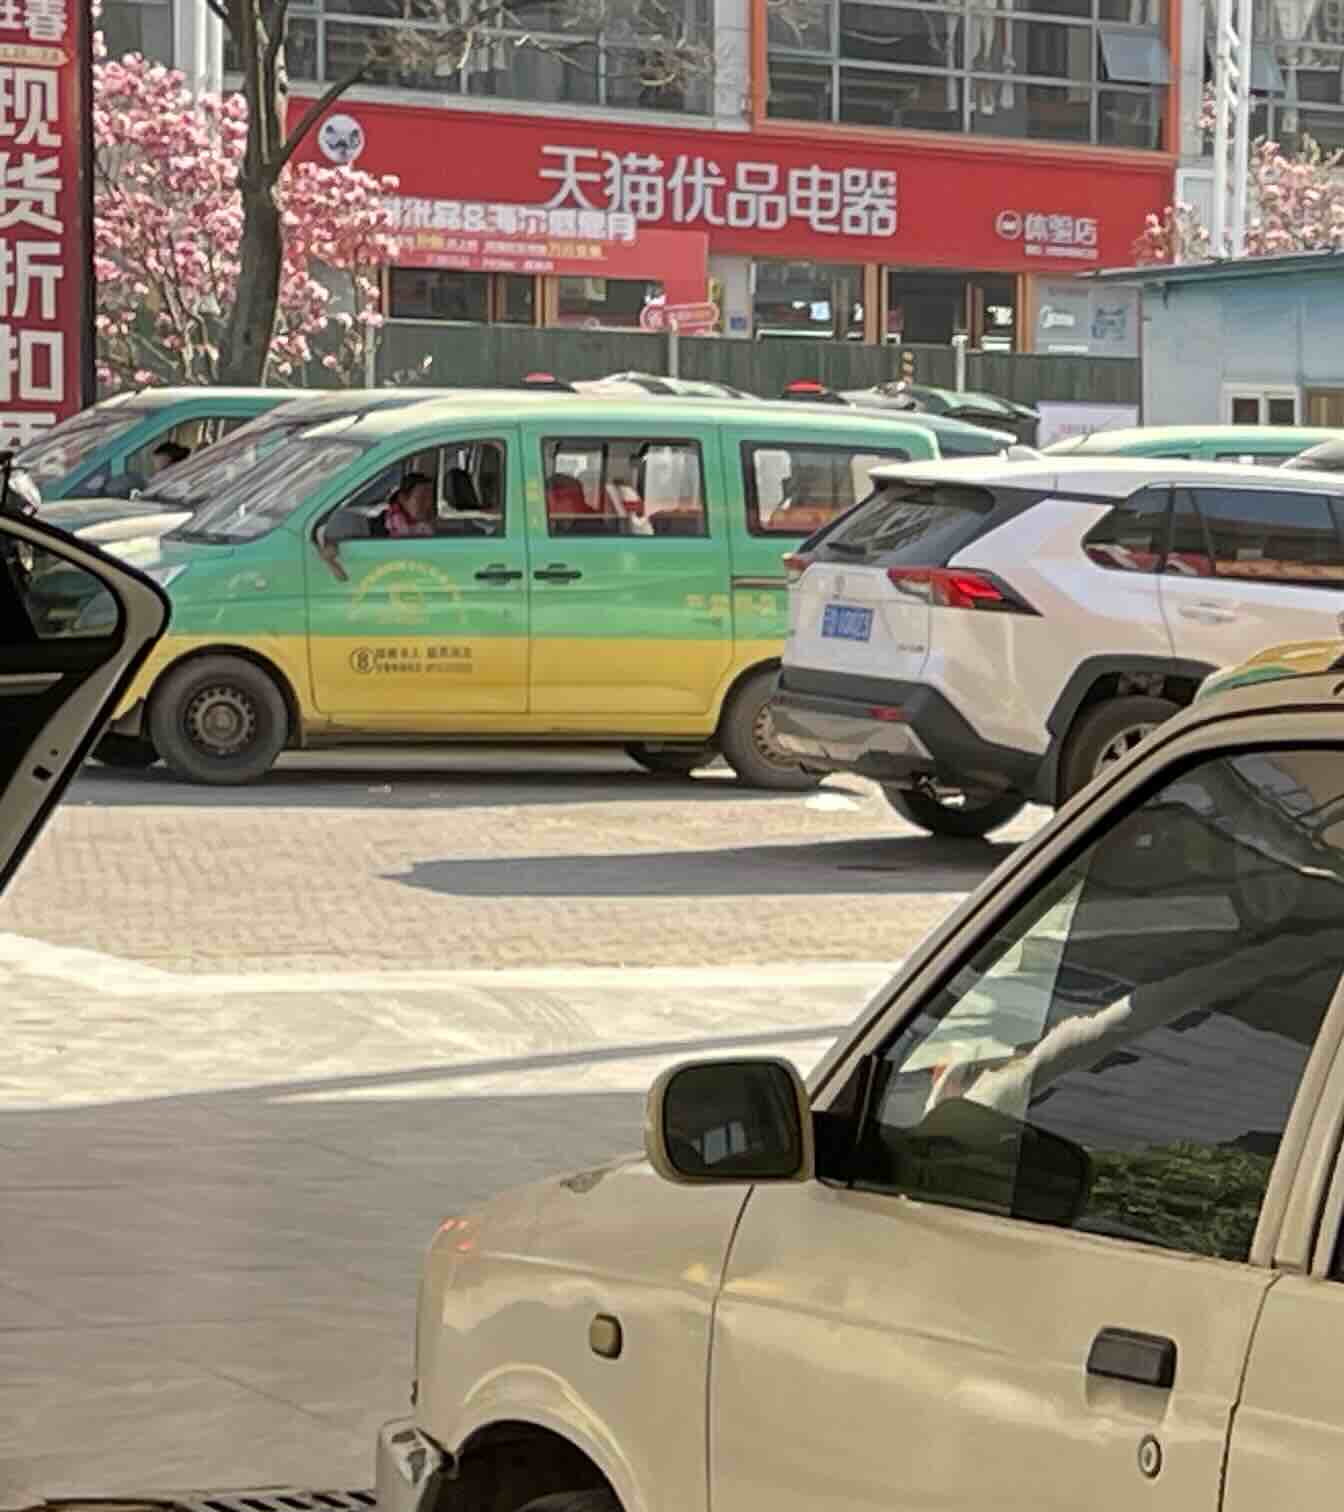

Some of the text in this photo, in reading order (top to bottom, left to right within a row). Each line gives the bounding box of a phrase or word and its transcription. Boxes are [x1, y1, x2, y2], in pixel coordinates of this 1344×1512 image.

[539, 145, 897, 237] 天猫优品电器
